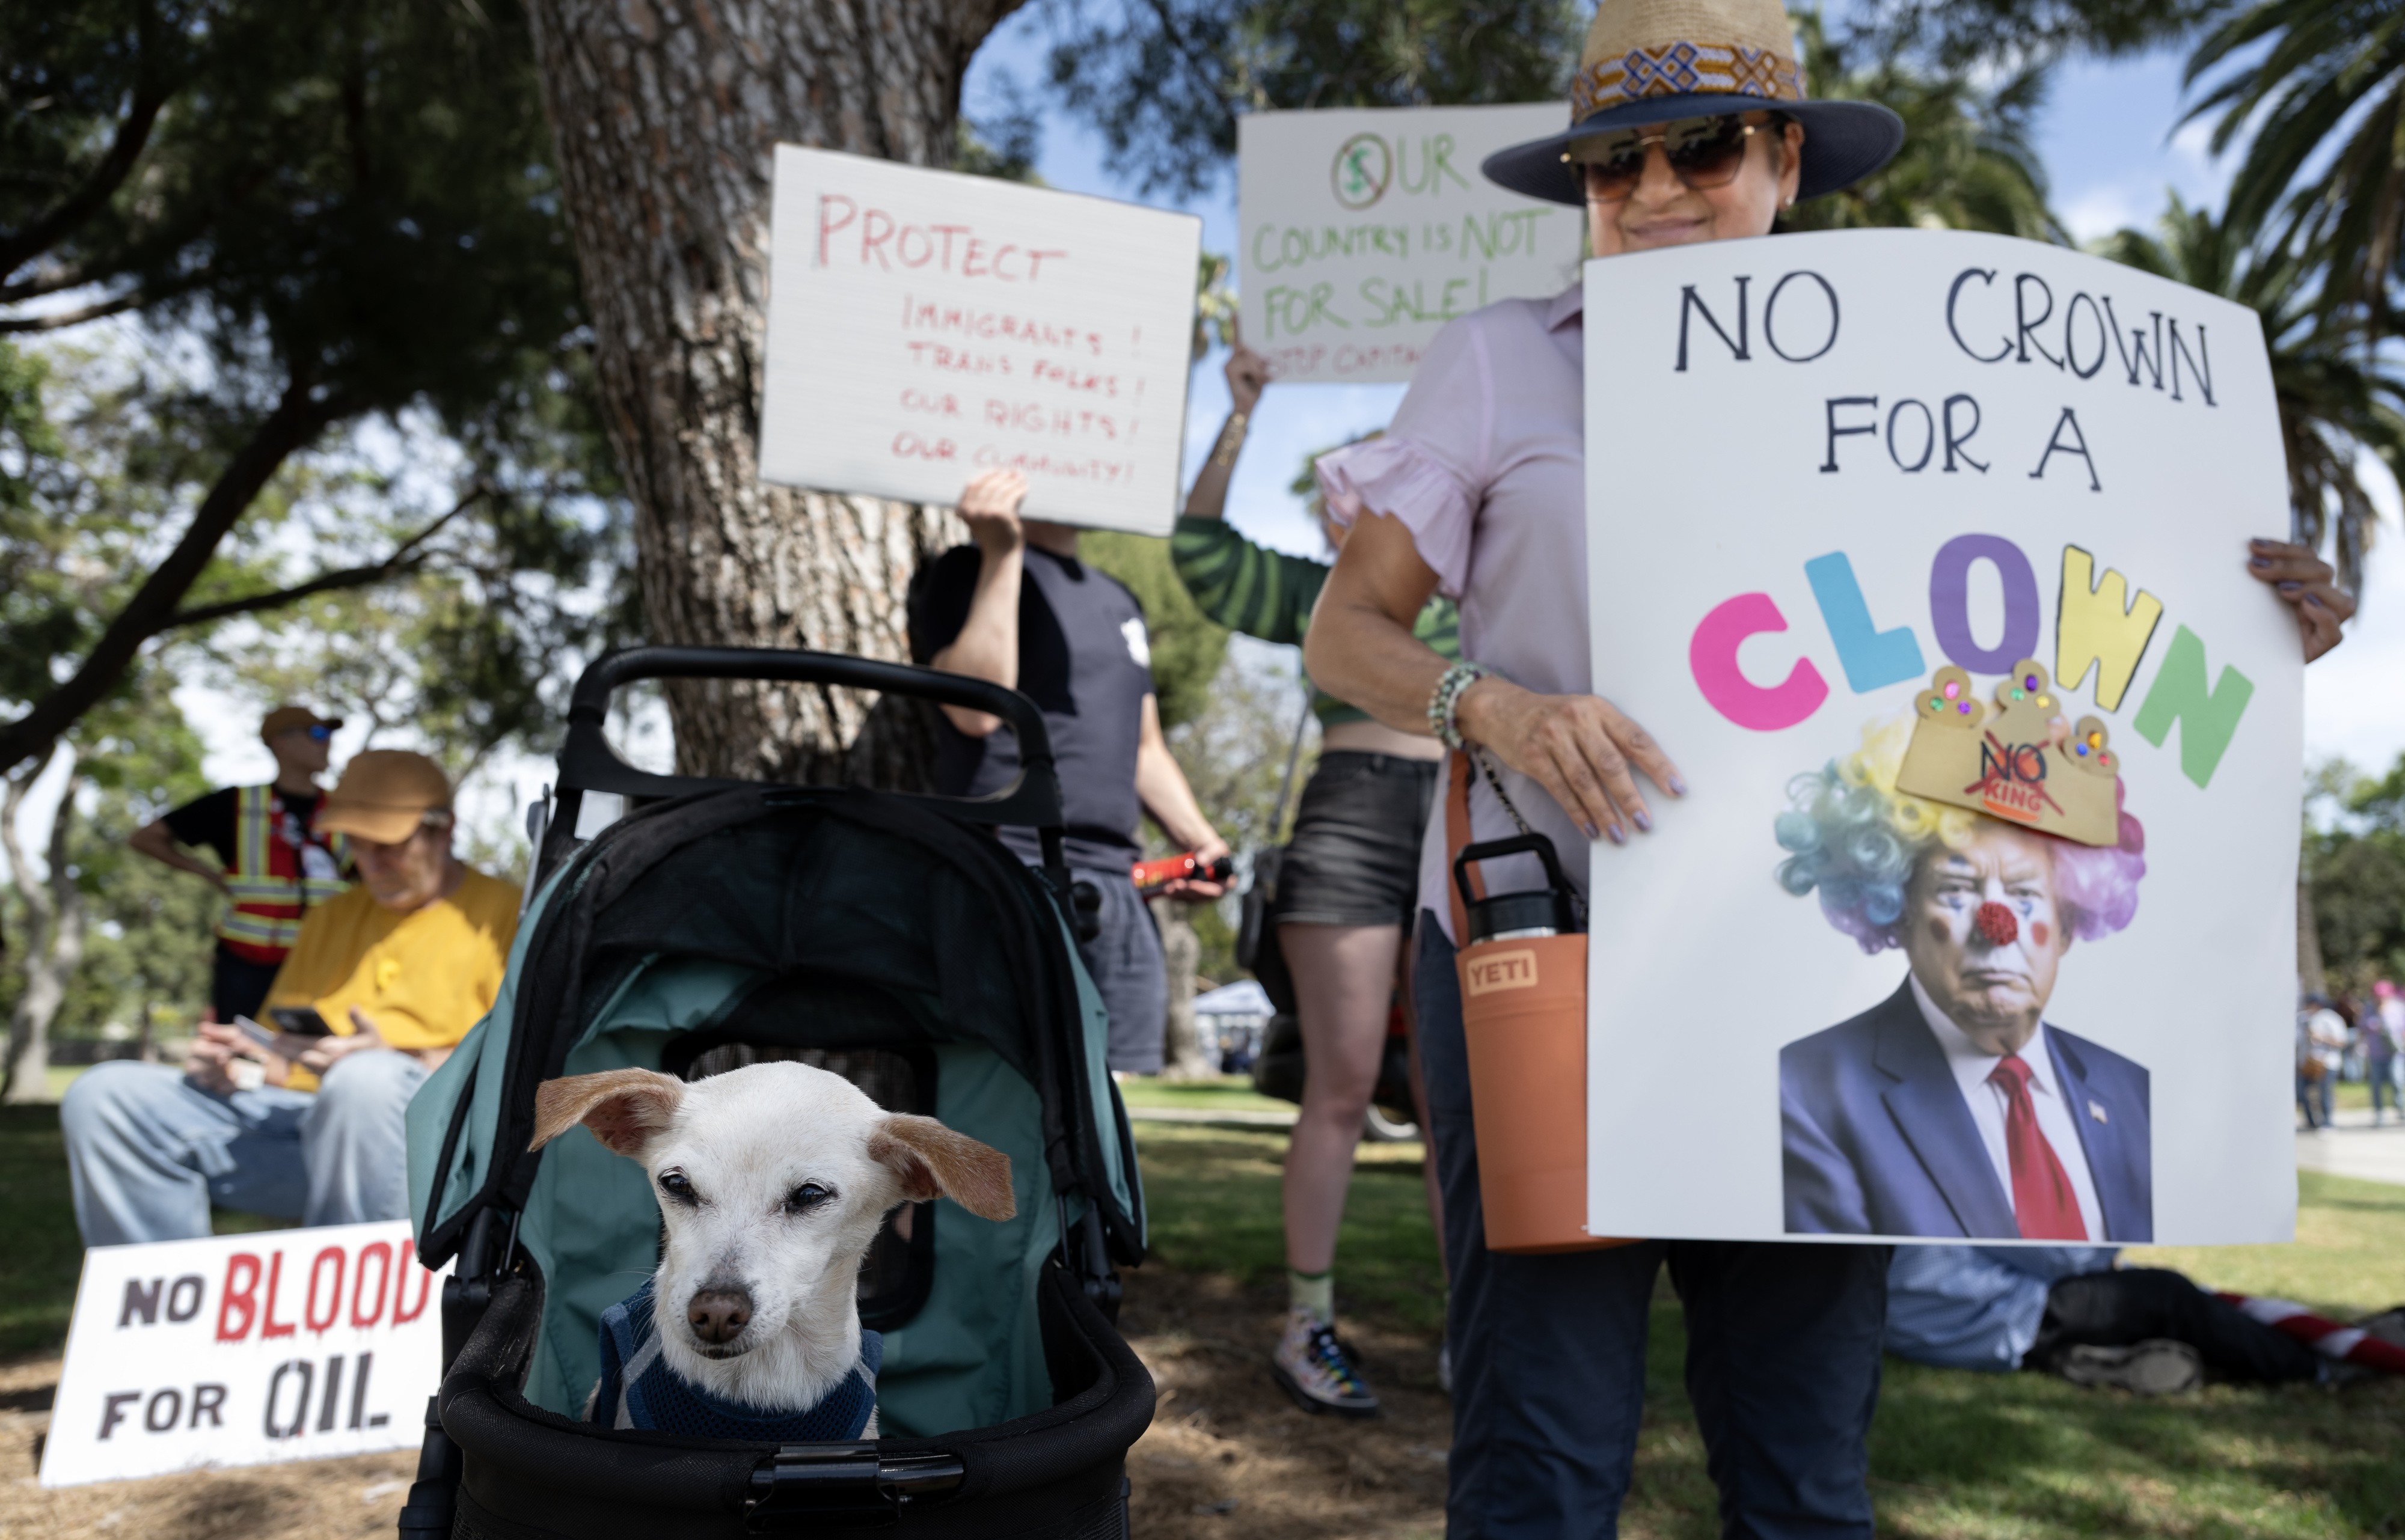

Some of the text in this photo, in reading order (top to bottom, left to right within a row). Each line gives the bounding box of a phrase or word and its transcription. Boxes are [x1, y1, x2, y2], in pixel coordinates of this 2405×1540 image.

[1331, 132, 1471, 211] OUR
[815, 192, 1068, 281] PROTECT
[1251, 207, 1554, 273] COUNTRY IS NOT
[1263, 266, 1488, 340] FOR SALE!
[1674, 268, 2217, 407] NO CROWN
[906, 340, 1012, 374] TRANS
[899, 388, 960, 418] OUR
[890, 430, 957, 460] OUR
[1820, 393, 2102, 491] FOR A
[1690, 533, 2255, 790] CLOWN
[1981, 741, 2047, 783] NO
[1984, 781, 2042, 811] KING
[1471, 958, 1530, 987] YETI
[117, 1238, 432, 1345] NO BLOOD
[97, 1352, 390, 1441] FOR OIL
